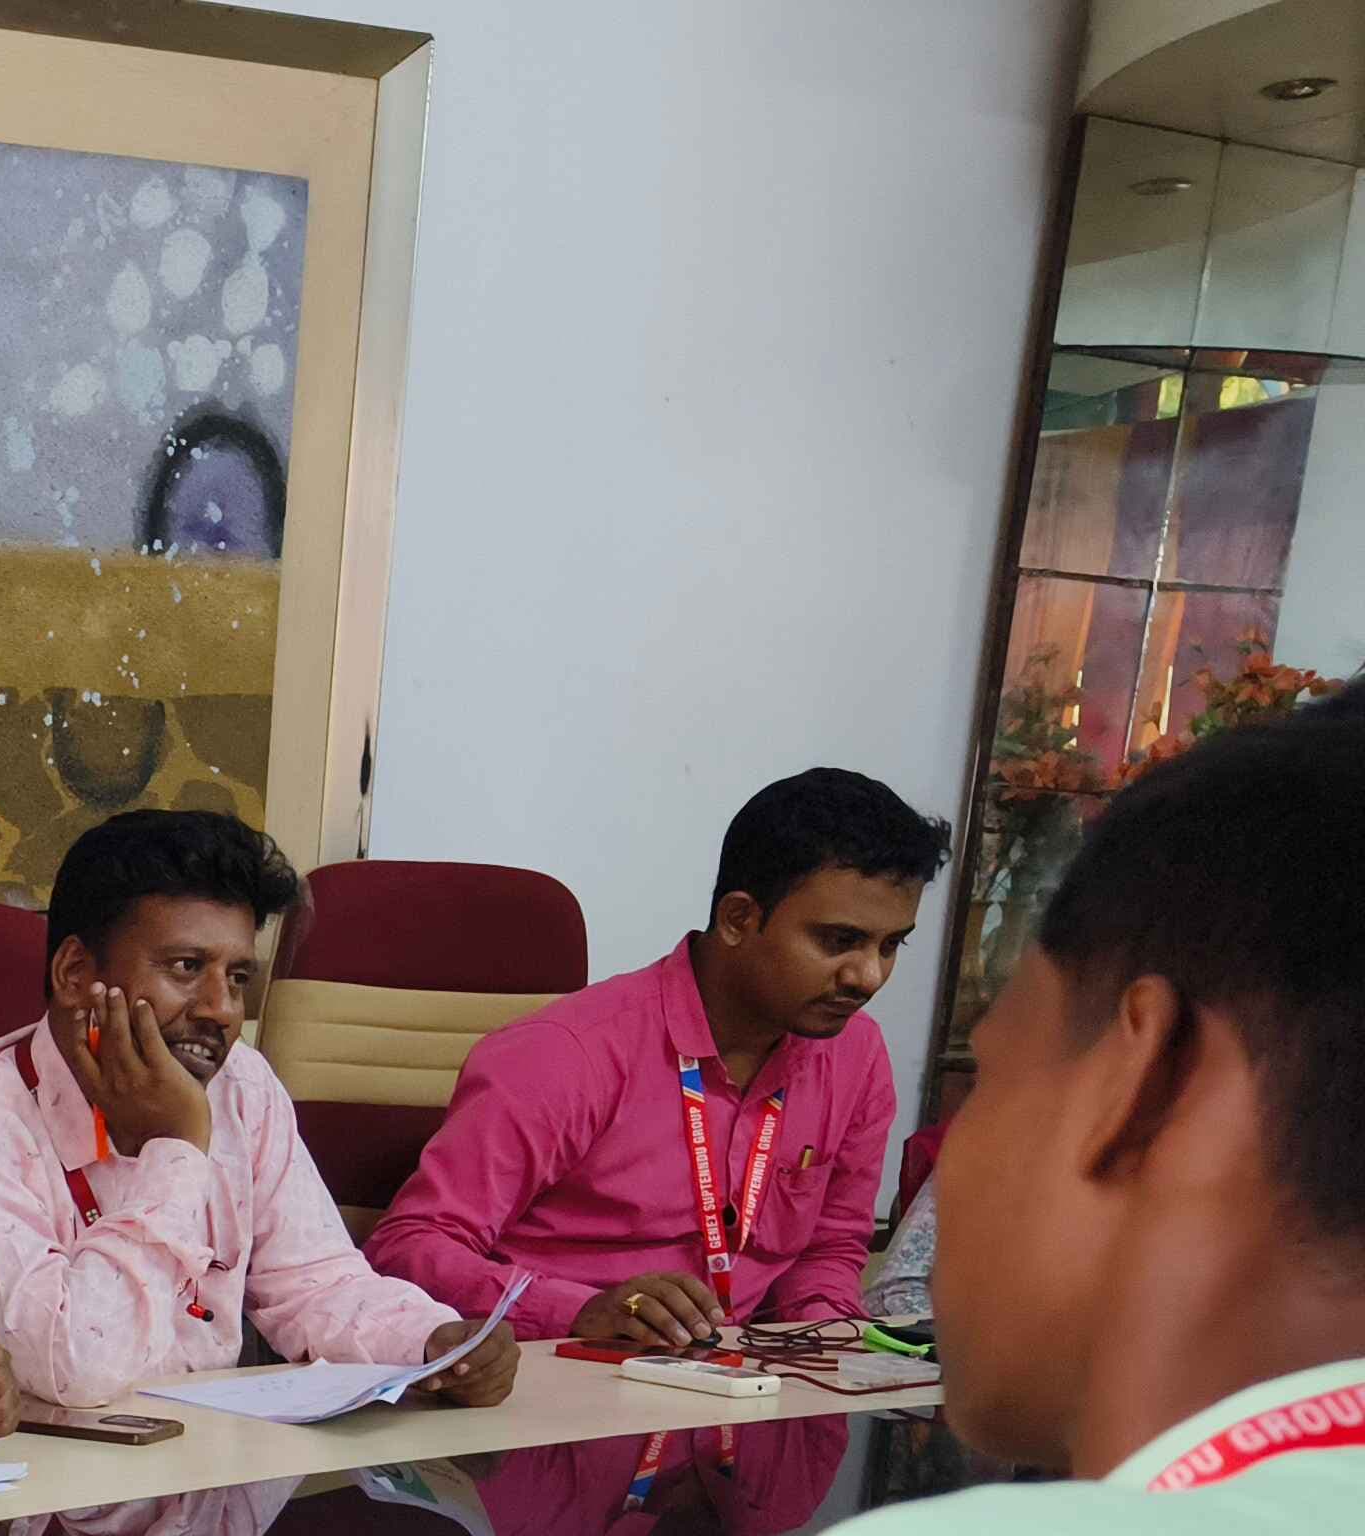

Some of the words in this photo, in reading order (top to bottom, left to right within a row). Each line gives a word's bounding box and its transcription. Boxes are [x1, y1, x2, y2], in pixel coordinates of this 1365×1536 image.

[690, 1106, 705, 1143] GROUP
[757, 1114, 776, 1150] GROUP
[706, 1215, 721, 1249] GENEX
[1228, 1386, 1365, 1454] GROU
